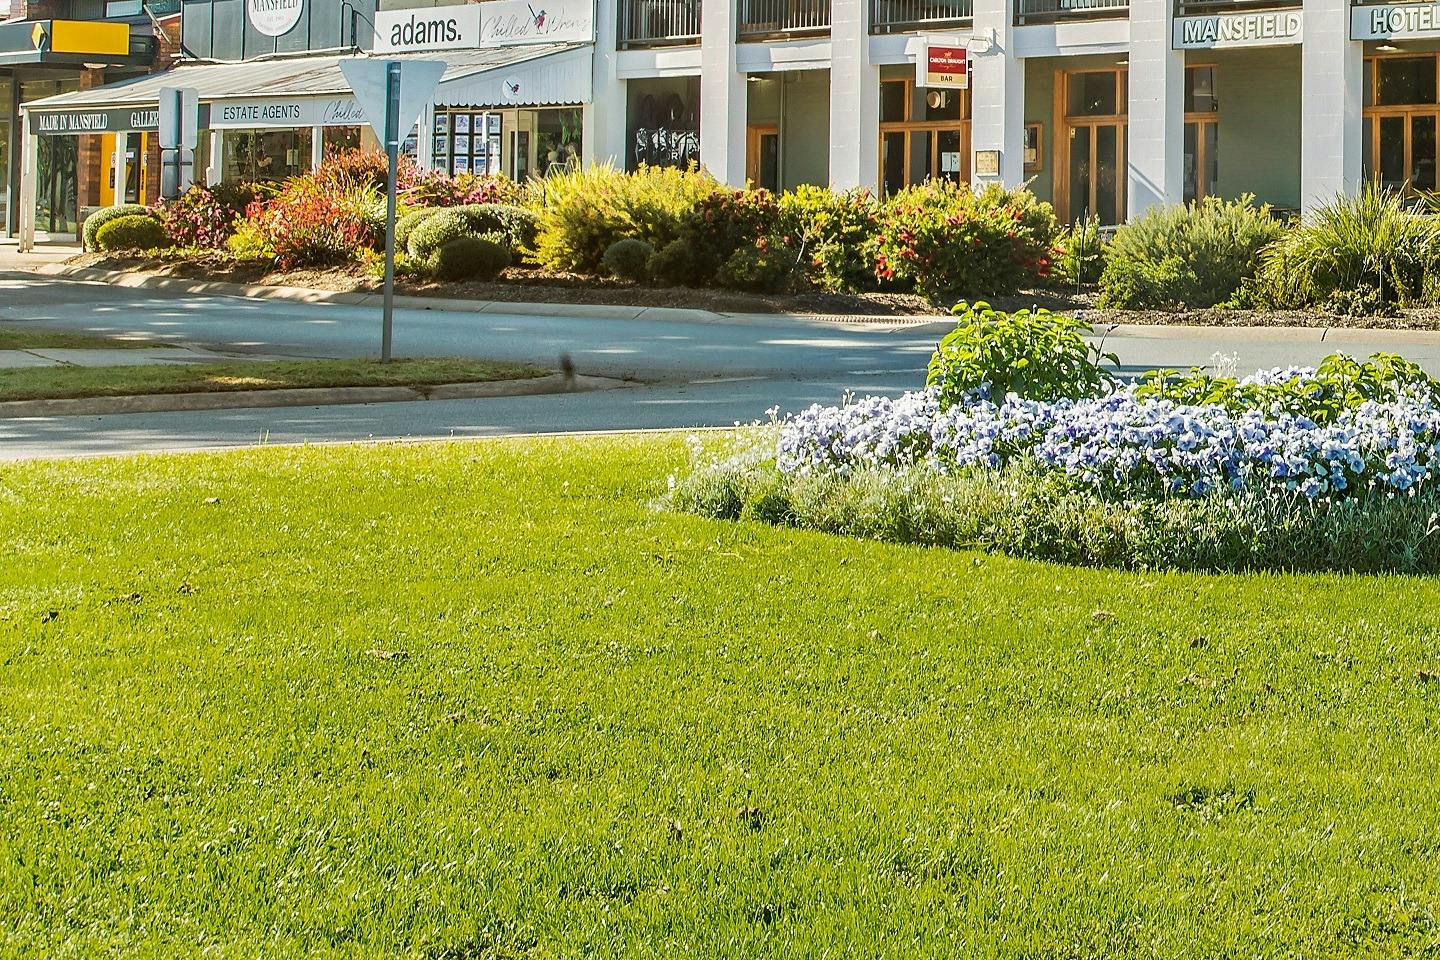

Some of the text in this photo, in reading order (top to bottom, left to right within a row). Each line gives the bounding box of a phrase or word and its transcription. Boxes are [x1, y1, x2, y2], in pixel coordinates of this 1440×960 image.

[390, 14, 462, 47] adams.
[481, 13, 532, 43] Chilled
[1183, 12, 1302, 44] MANSFIELD
[39, 113, 108, 130] MADE IN MANSFIELD
[130, 110, 160, 128] GALLER
[223, 104, 300, 120] ESTATE AGENTS
[324, 98, 365, 124] Chilled
